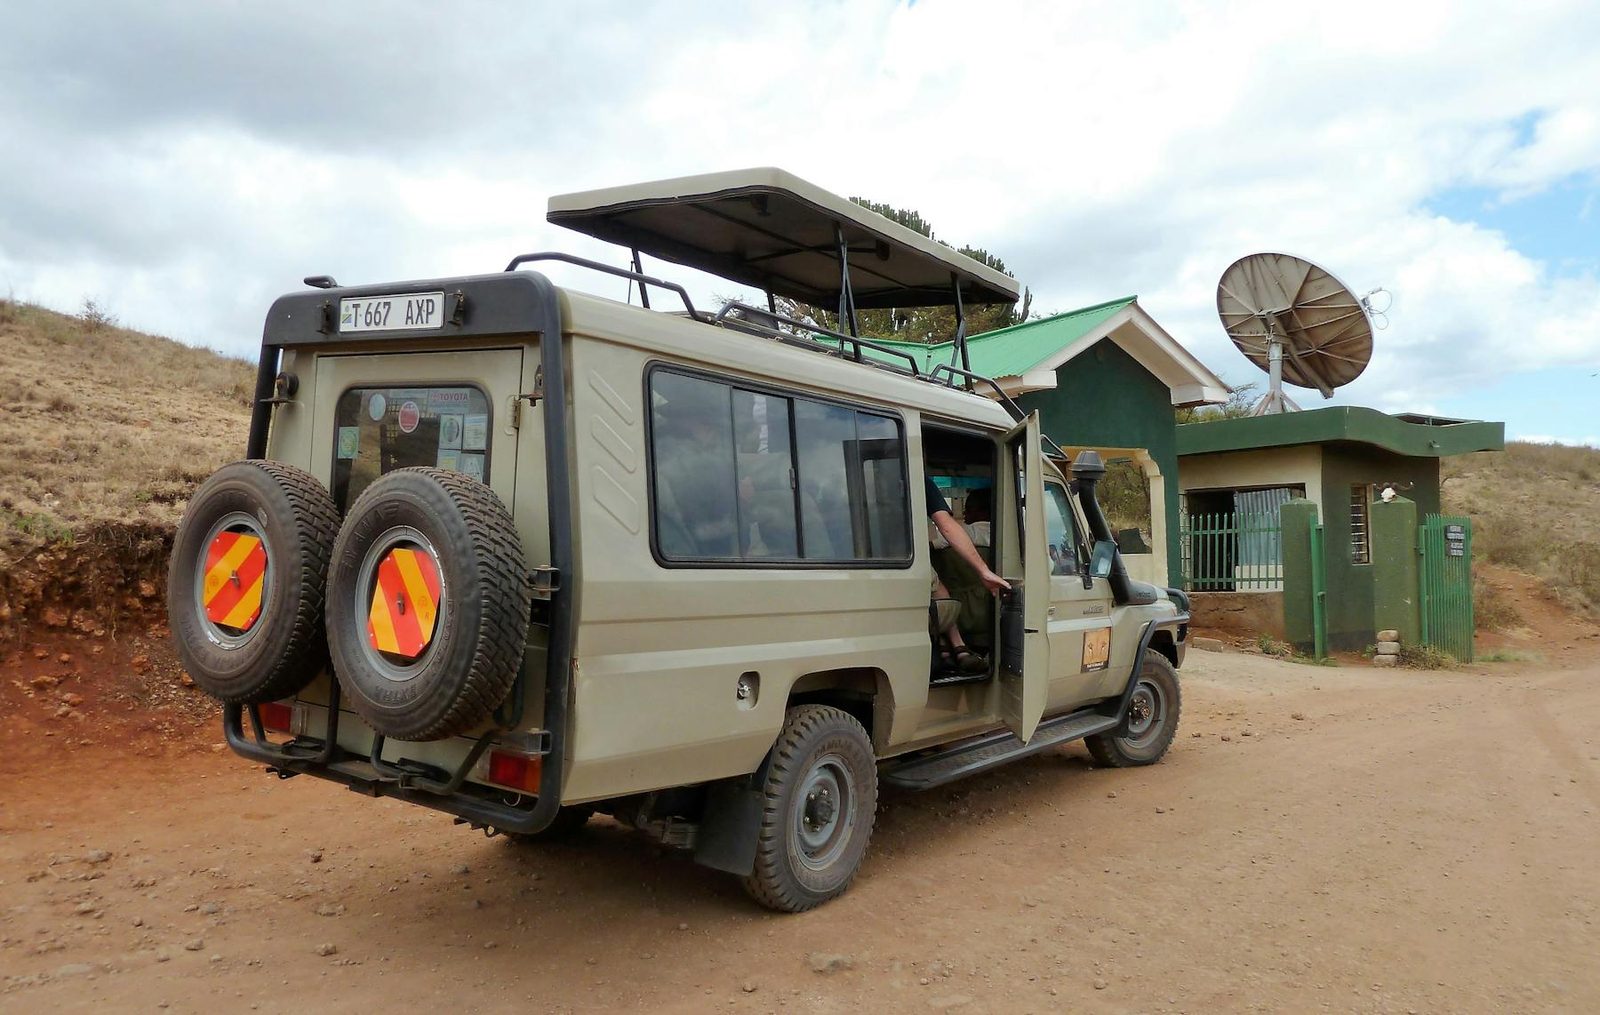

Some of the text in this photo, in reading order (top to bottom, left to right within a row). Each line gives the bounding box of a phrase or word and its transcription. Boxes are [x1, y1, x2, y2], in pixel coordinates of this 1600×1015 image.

[352, 299, 434, 327] T 667 AXP
[440, 392, 468, 401] TOYOTA
